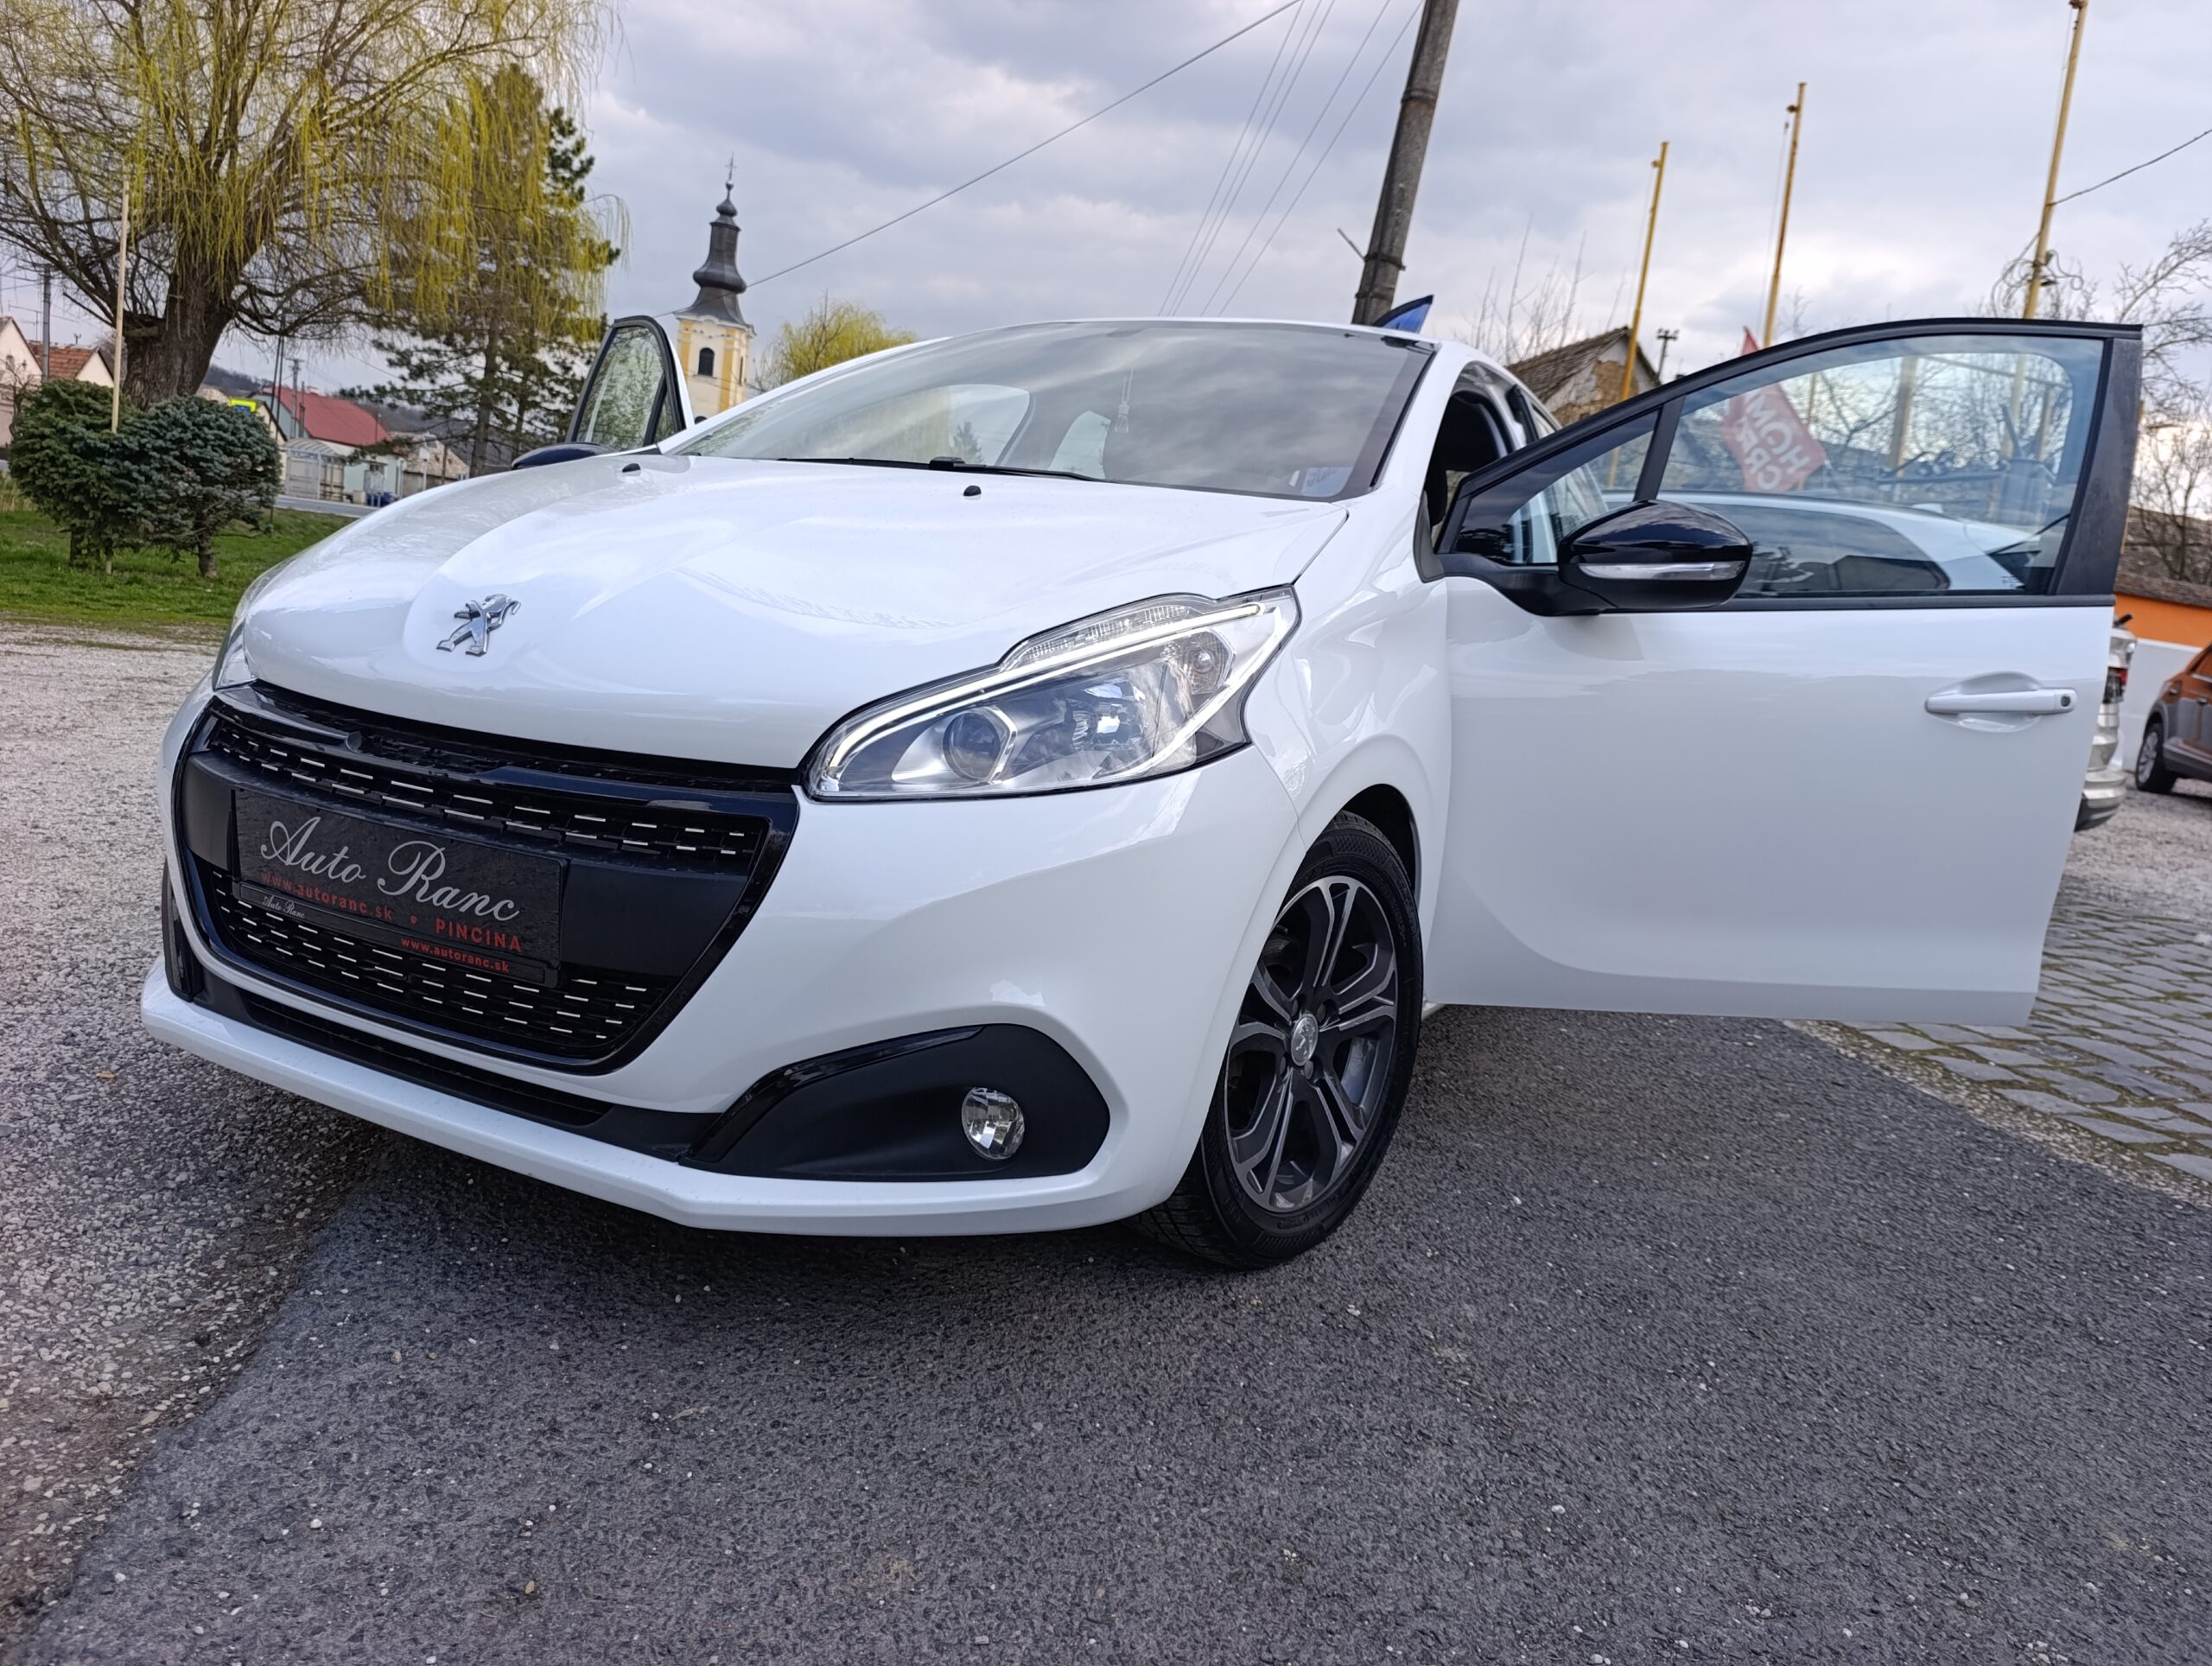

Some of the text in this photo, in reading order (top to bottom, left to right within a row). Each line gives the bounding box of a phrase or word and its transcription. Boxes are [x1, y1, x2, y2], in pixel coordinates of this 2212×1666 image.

[261, 817, 519, 921] Auto Ranc
[262, 895, 306, 919] Auto Ranc
[262, 872, 522, 953] www.autoranc.sk PINCINA
[400, 938, 510, 973] www.autoranc.sk
